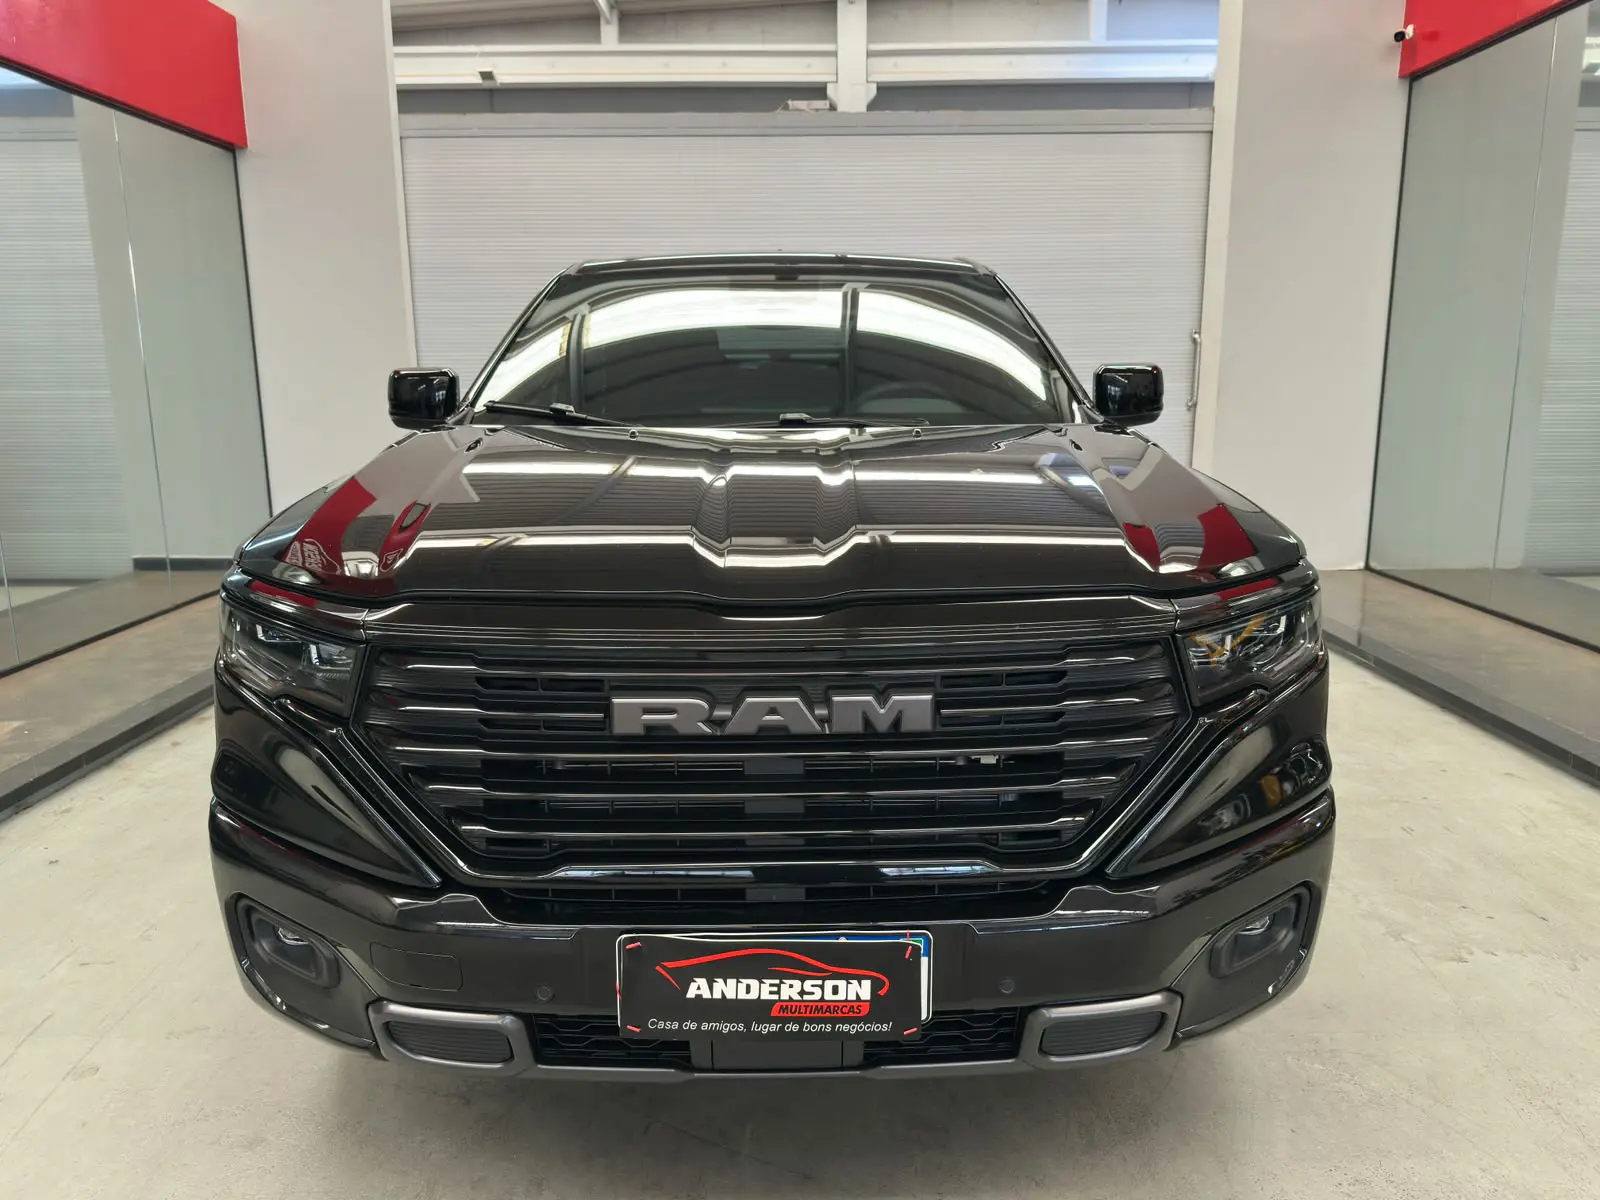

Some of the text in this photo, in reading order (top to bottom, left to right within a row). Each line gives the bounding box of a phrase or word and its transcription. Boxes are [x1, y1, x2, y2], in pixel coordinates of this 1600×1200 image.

[611, 695, 934, 735] RAM
[686, 977, 871, 1001] ANDERSON
[777, 1004, 863, 1015] MULTIMARCAS
[648, 1018, 893, 1034] Casa de amigos, lugar de bons negócios!
